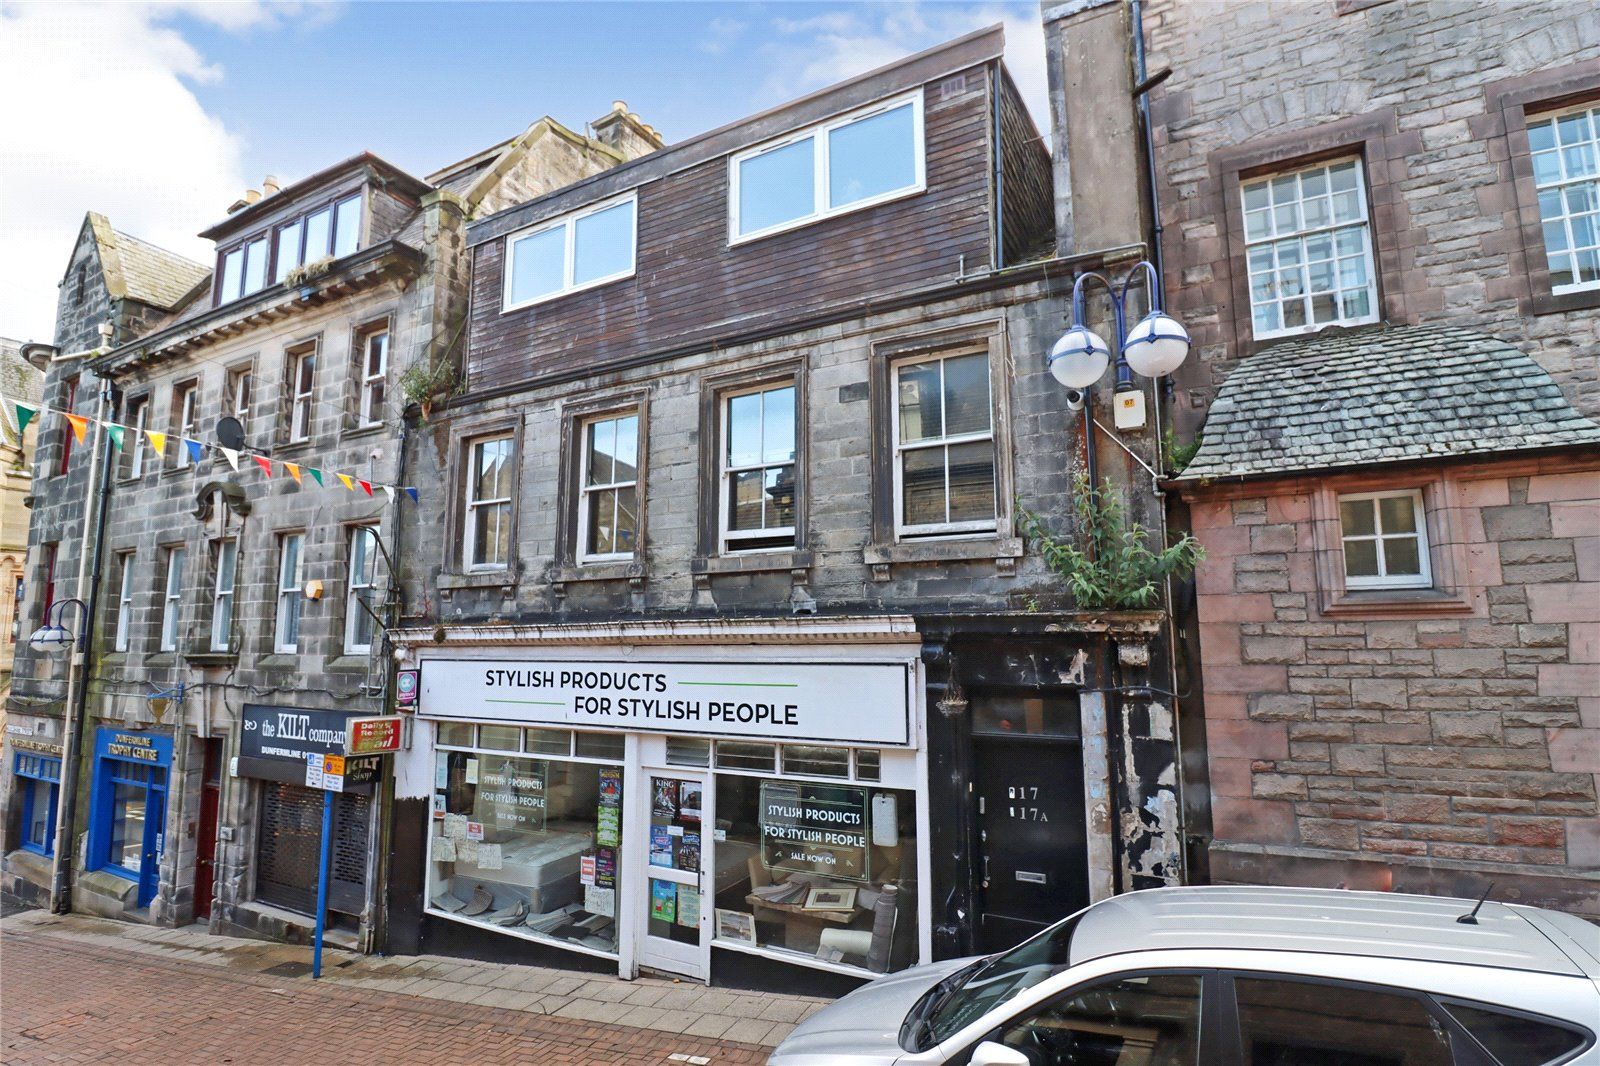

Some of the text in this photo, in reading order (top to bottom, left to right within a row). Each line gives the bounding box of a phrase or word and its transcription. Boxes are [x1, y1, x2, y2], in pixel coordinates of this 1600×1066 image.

[485, 670, 667, 692] STYLISH PRODUCTS
[574, 696, 799, 725] FOR STYLISH PEOPLE
[262, 720, 275, 737] the
[277, 713, 310, 740] KILT
[132, 746, 158, 761] CENTRE
[261, 746, 302, 759] DUNFERMLINE
[346, 757, 380, 775] KILT
[353, 769, 373, 781] shop
[484, 775, 543, 790] STYLISH PRODUCTS
[656, 779, 675, 789] KING
[481, 792, 545, 808] FOR STYLISH PEOPLE
[1019, 786, 1038, 800] 17
[768, 805, 861, 825] STYLISH PRODUCTS
[1020, 807, 1049, 822] 17A
[764, 825, 866, 848] FOR STYLISH PEOPLE
[791, 851, 837, 865] SALE NOW ON
